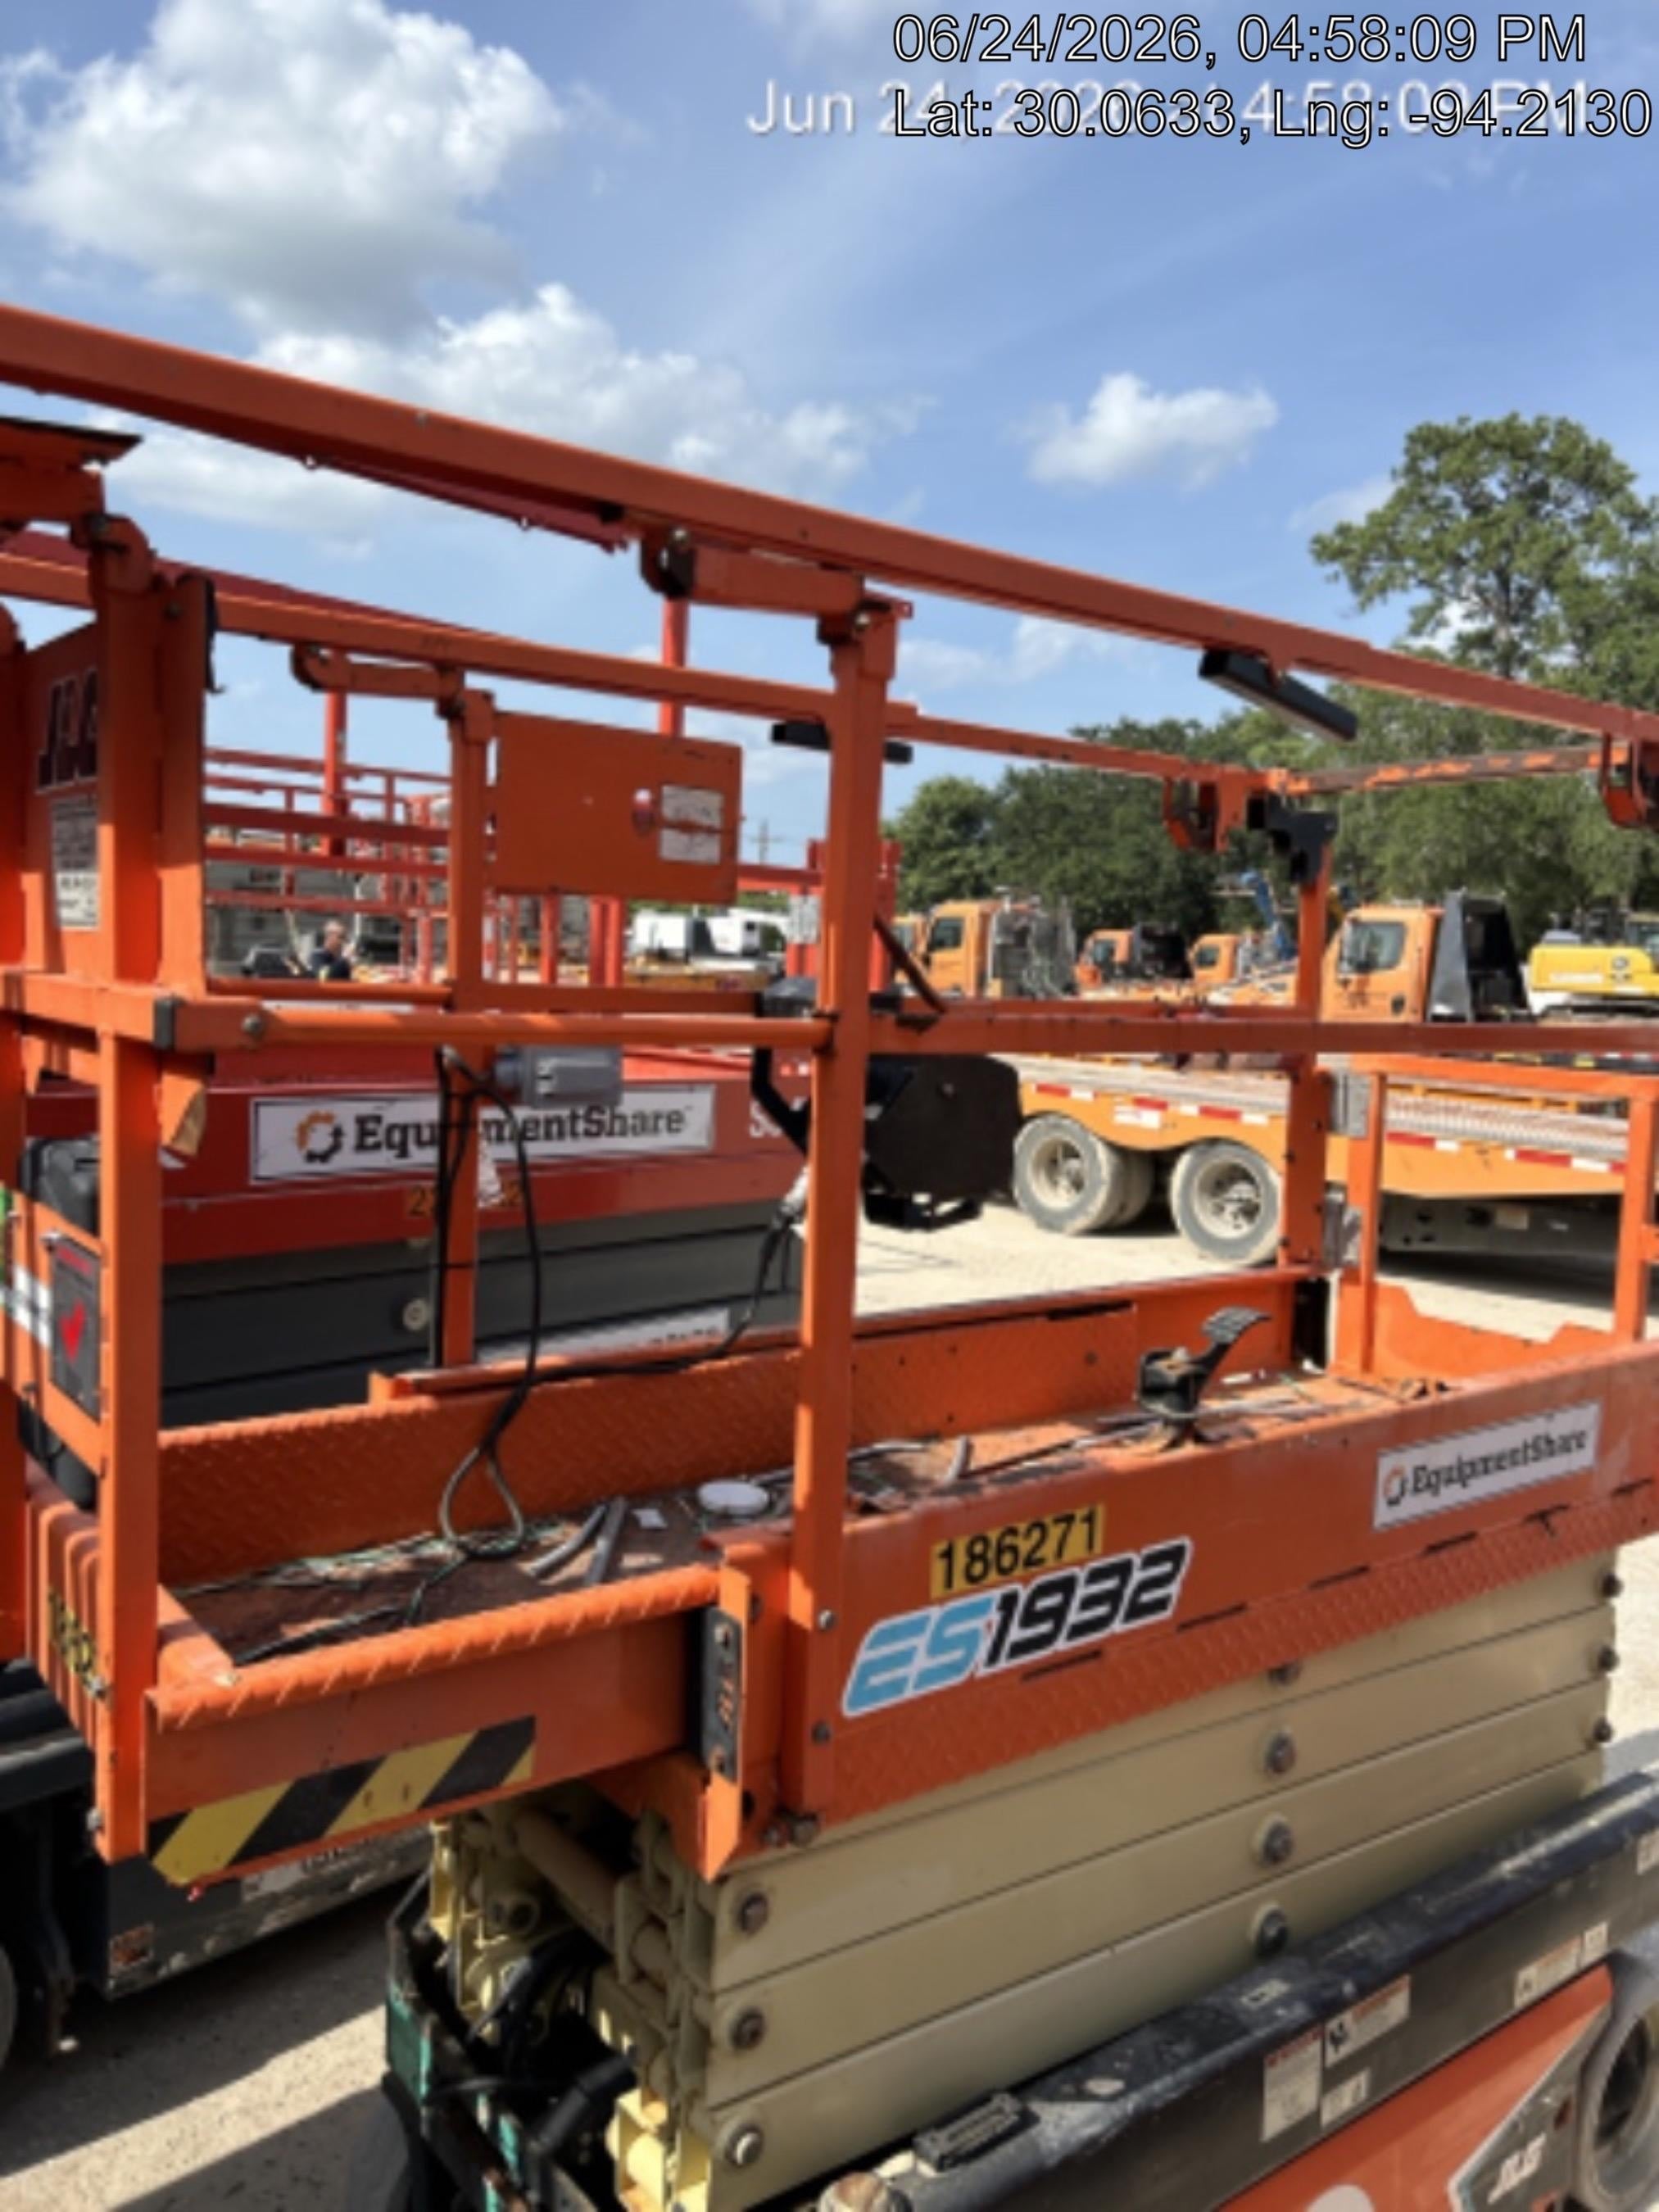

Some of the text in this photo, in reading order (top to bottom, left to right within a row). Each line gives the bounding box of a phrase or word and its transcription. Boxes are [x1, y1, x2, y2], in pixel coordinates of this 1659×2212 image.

[355, 1104, 685, 1158] EqumentShare
[936, 1506, 1098, 1590] 186271
[844, 1540, 1190, 1715] ES1932
